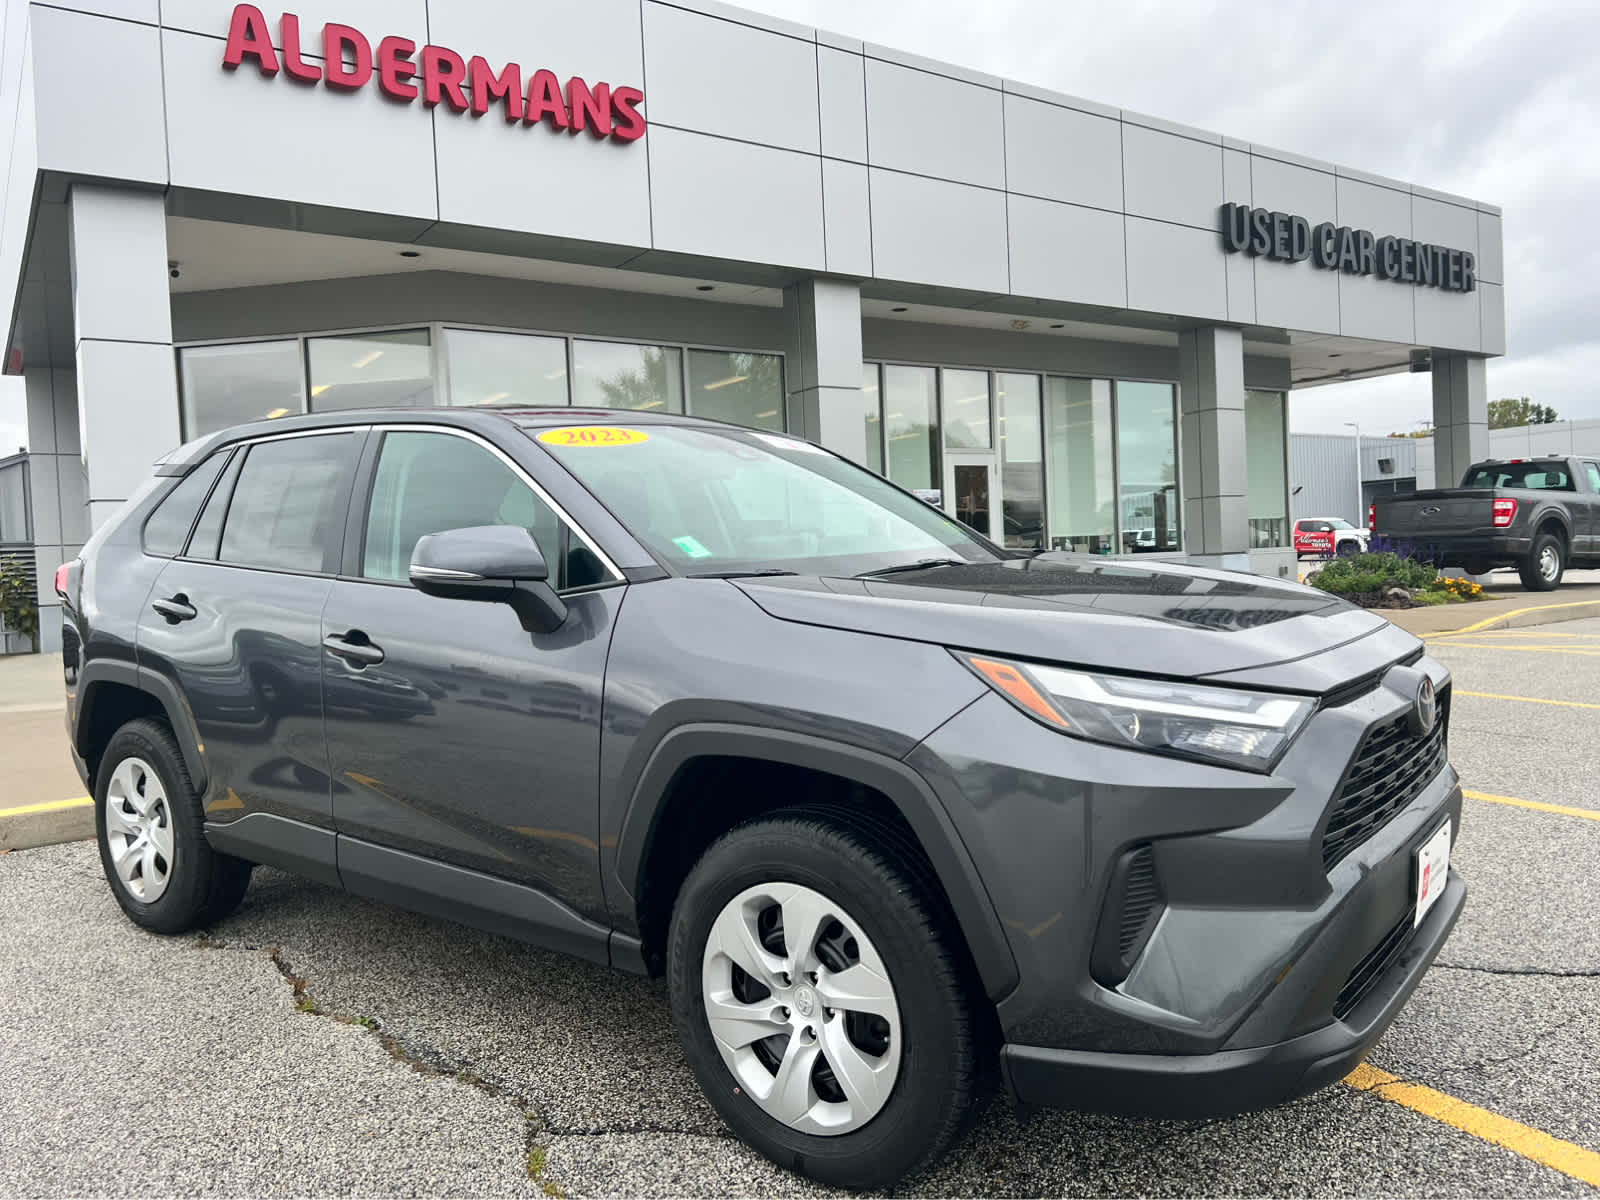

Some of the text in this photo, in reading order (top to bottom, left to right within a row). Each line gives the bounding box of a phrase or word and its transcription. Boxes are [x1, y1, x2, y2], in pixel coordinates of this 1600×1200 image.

[222, 3, 646, 144] ALDERMANS
[1222, 202, 1476, 293] USED CAR CENTER
[561, 429, 632, 444] 2023
